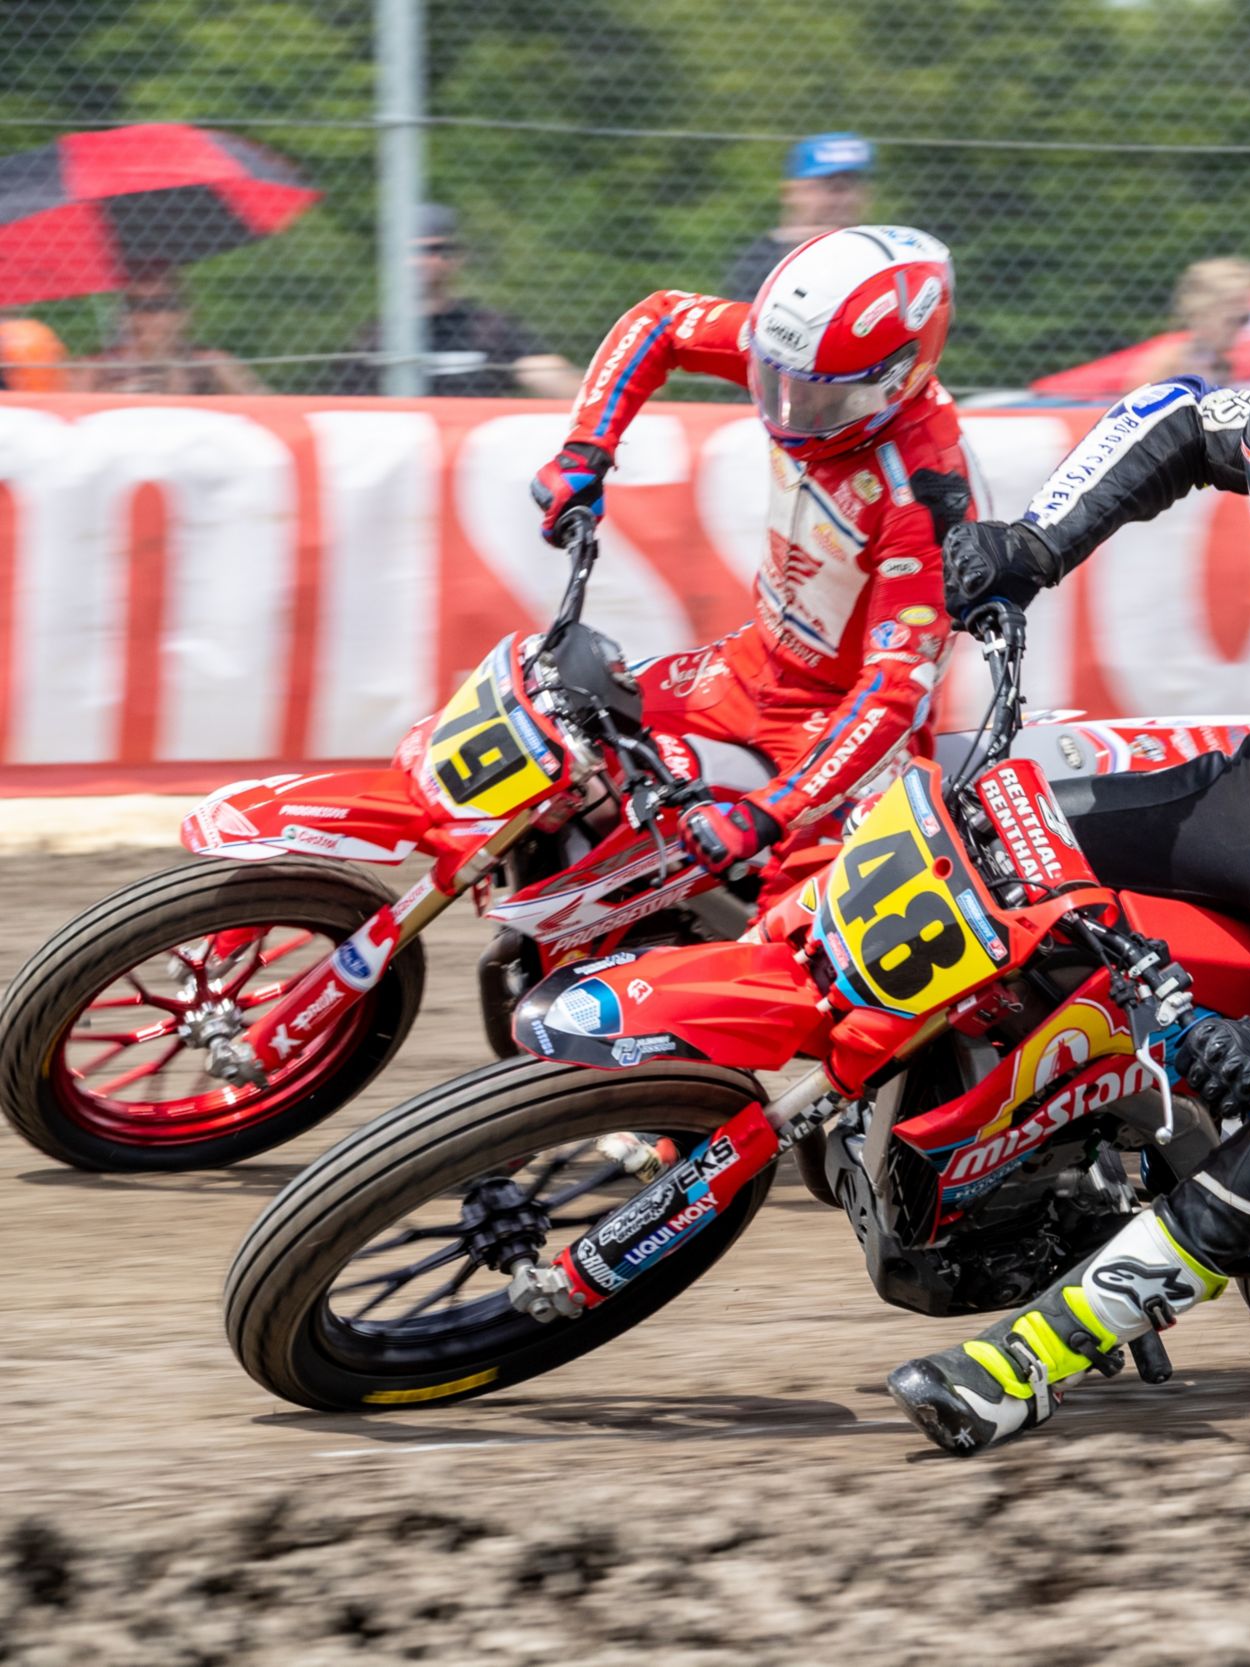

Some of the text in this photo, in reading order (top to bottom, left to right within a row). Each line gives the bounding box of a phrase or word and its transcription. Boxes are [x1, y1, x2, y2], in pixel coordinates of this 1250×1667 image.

[586, 315, 653, 407] HONDA
[431, 676, 528, 805] 79
[801, 707, 887, 797] HONDA
[278, 804, 350, 819] PROGRESSIVE
[982, 779, 1044, 892] RENTHAL
[998, 768, 1063, 880] RENTHAL
[837, 830, 967, 1001] 48
[677, 1136, 735, 1192] EKS
[951, 1055, 1153, 1181] mission
[625, 1191, 719, 1265] LIQUI MOLY
